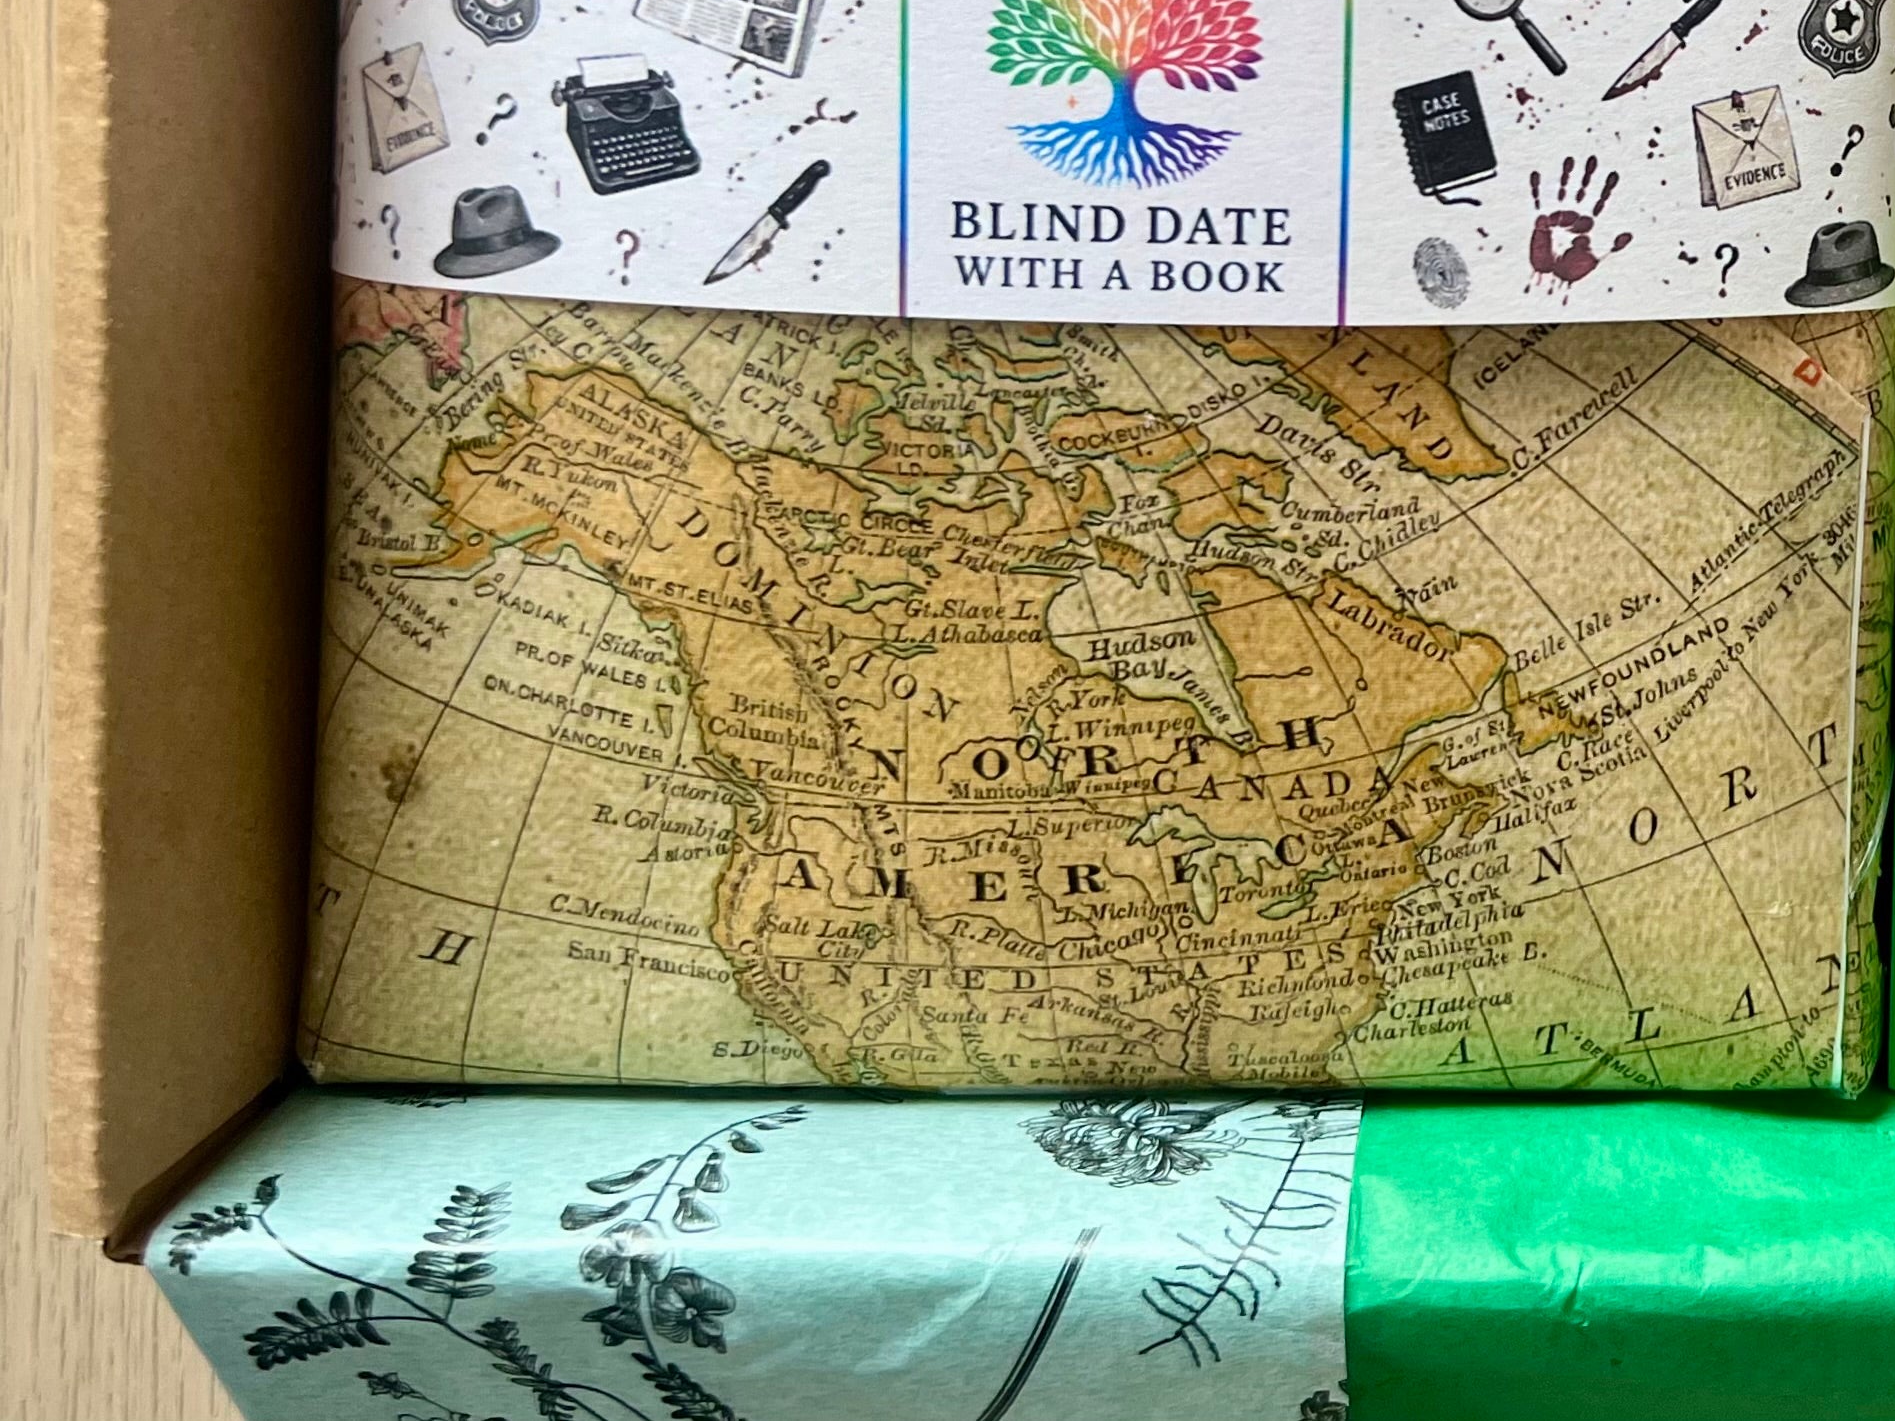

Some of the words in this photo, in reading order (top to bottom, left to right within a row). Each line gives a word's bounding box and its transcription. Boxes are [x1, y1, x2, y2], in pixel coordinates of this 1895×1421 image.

[1810, 33, 1867, 65] POLICE
[1421, 91, 1462, 116] CASE
[1423, 109, 1471, 135] NOTES
[1723, 161, 1788, 191] EVIDENCE
[950, 200, 1127, 244] BLIND
[1147, 206, 1293, 247] DATE
[954, 255, 1083, 291] WITH
[1101, 259, 1133, 291] A
[1150, 260, 1285, 294] BOOK
[443, 371, 507, 432] Bering
[577, 382, 688, 450] ALASKA
[1186, 382, 1246, 420] DISKO
[884, 442, 975, 460] VICTORIA
[1255, 412, 1337, 465] Davis
[1280, 495, 1422, 522] Cumberland
[1688, 518, 1763, 594] Atlantic
[1759, 448, 1847, 524] Telegraph
[386, 581, 451, 639] UNIMAK
[496, 589, 571, 630] KADIAK
[1325, 589, 1457, 666] Labrador
[1739, 599, 1779, 644] New
[1083, 629, 1197, 663] Hudson
[1537, 615, 1731, 721] NEWFOUNDLAND
[728, 692, 809, 725] British
[1069, 685, 1127, 711] York
[547, 723, 665, 766] VANCOUVER
[706, 716, 820, 751] Columbia
[1075, 715, 1196, 741] Winnipeg
[1579, 742, 1648, 784] Scotia
[641, 772, 738, 808] Victoria
[1152, 764, 1394, 801] CANADA
[623, 807, 740, 843] Columbia
[1298, 796, 1371, 823] Quebec
[1492, 795, 1579, 836] Halifax
[1311, 835, 1378, 857] Ottawa
[1426, 837, 1498, 867] Boston
[1339, 863, 1408, 883] Ontario
[1470, 853, 1512, 878] Cod
[1399, 899, 1443, 921] New
[1449, 884, 1502, 909] York
[765, 914, 811, 935] Salt
[815, 919, 879, 939] Lake
[1058, 925, 1159, 961] Chicago
[1175, 927, 1306, 955] Cincinnati
[566, 940, 612, 965] San
[620, 945, 732, 985] Francisco
[816, 939, 867, 961] City
[1373, 929, 1514, 965] Washington
[779, 961, 1038, 991] UNITED
[1096, 942, 1346, 989] STATES
[920, 1005, 988, 1025] Santa
[1026, 994, 1137, 1033] Arkansas
[1352, 1017, 1472, 1045] Charleston
